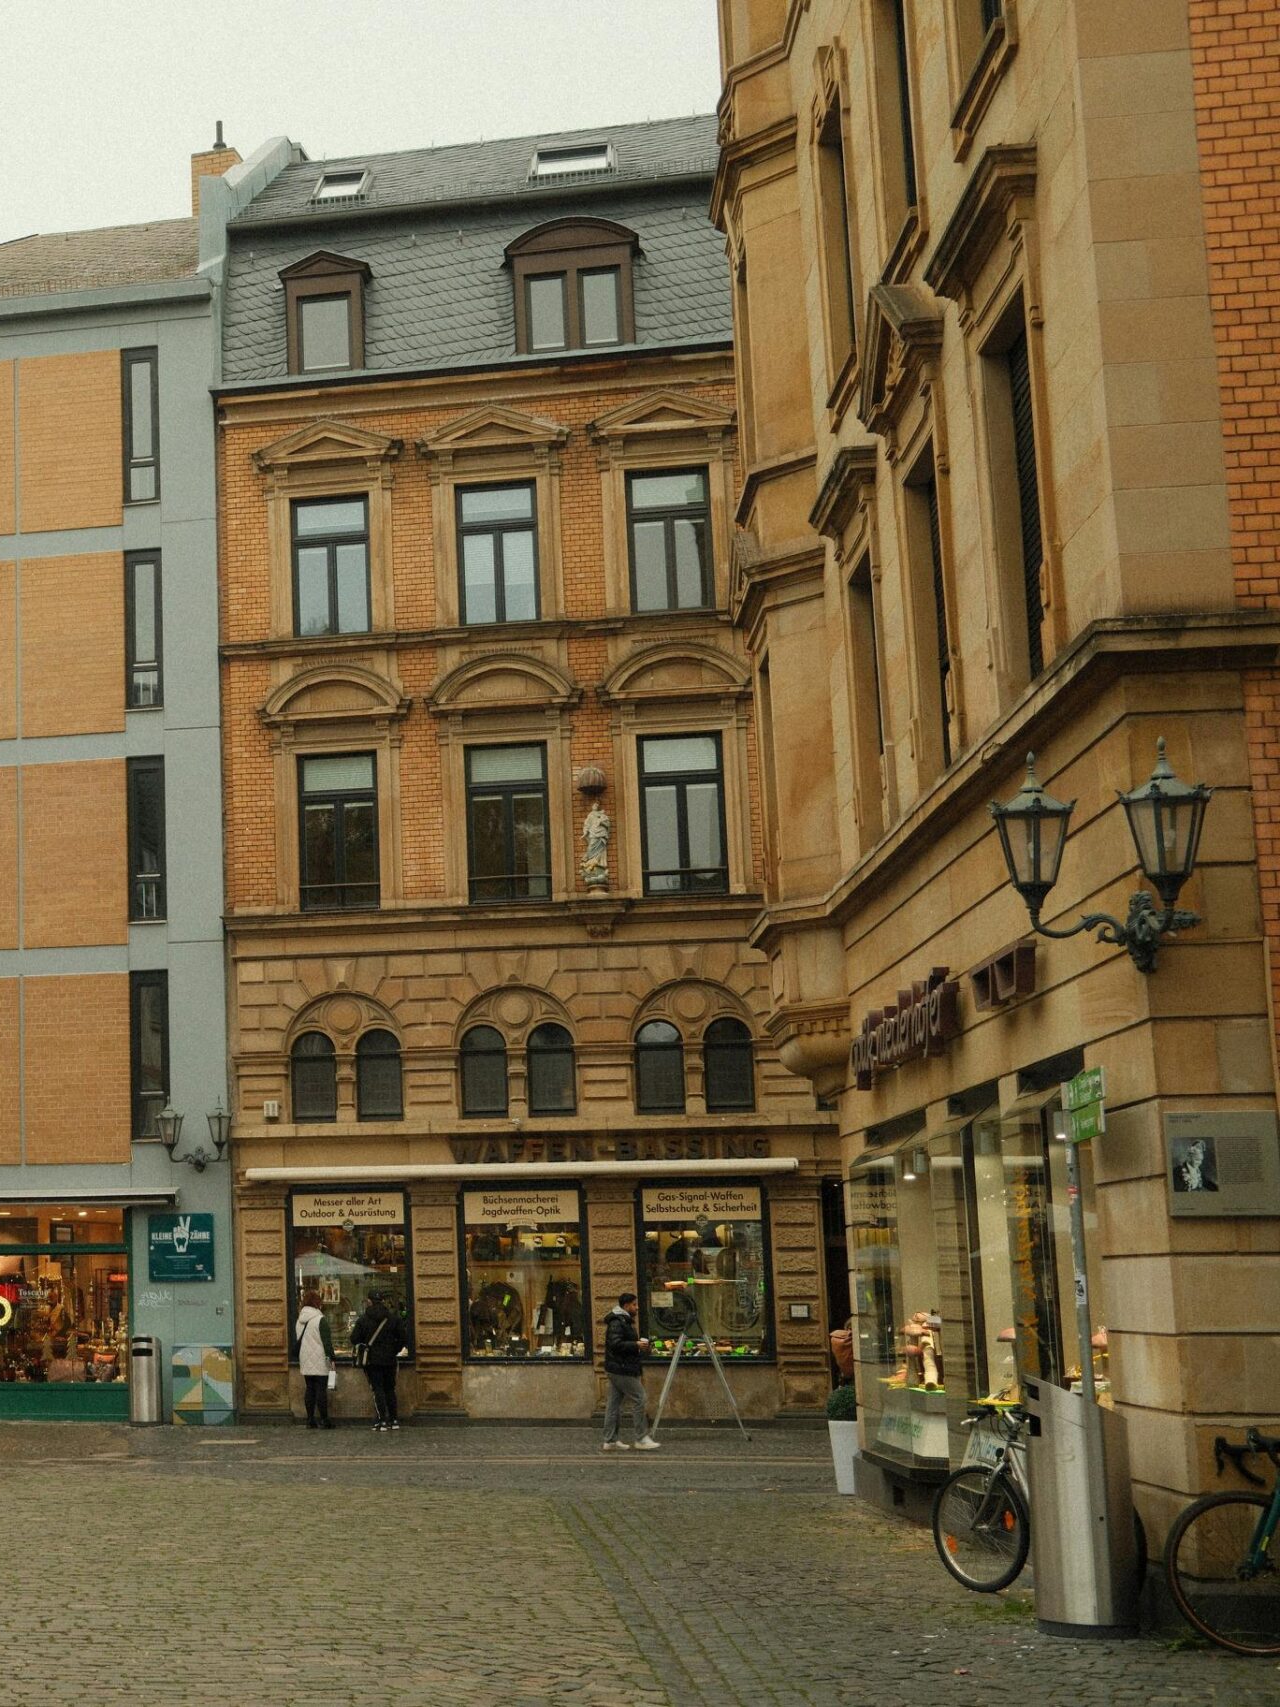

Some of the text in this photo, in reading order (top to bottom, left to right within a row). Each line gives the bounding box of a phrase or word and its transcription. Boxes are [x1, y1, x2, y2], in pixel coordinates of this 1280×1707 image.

[482, 1194, 559, 1205] Büchsenmacherei
[657, 1191, 744, 1201] Gas-Signal-Waffen
[313, 1197, 381, 1207] Messer aller Art
[481, 1205, 561, 1217] Jagdwaffen-Optik
[646, 1202, 757, 1213] Selbstschutz & Sicherheit
[300, 1208, 396, 1218] Outdoor & Ausrüstung
[151, 1230, 210, 1240] KLEINE ZÄHNE
